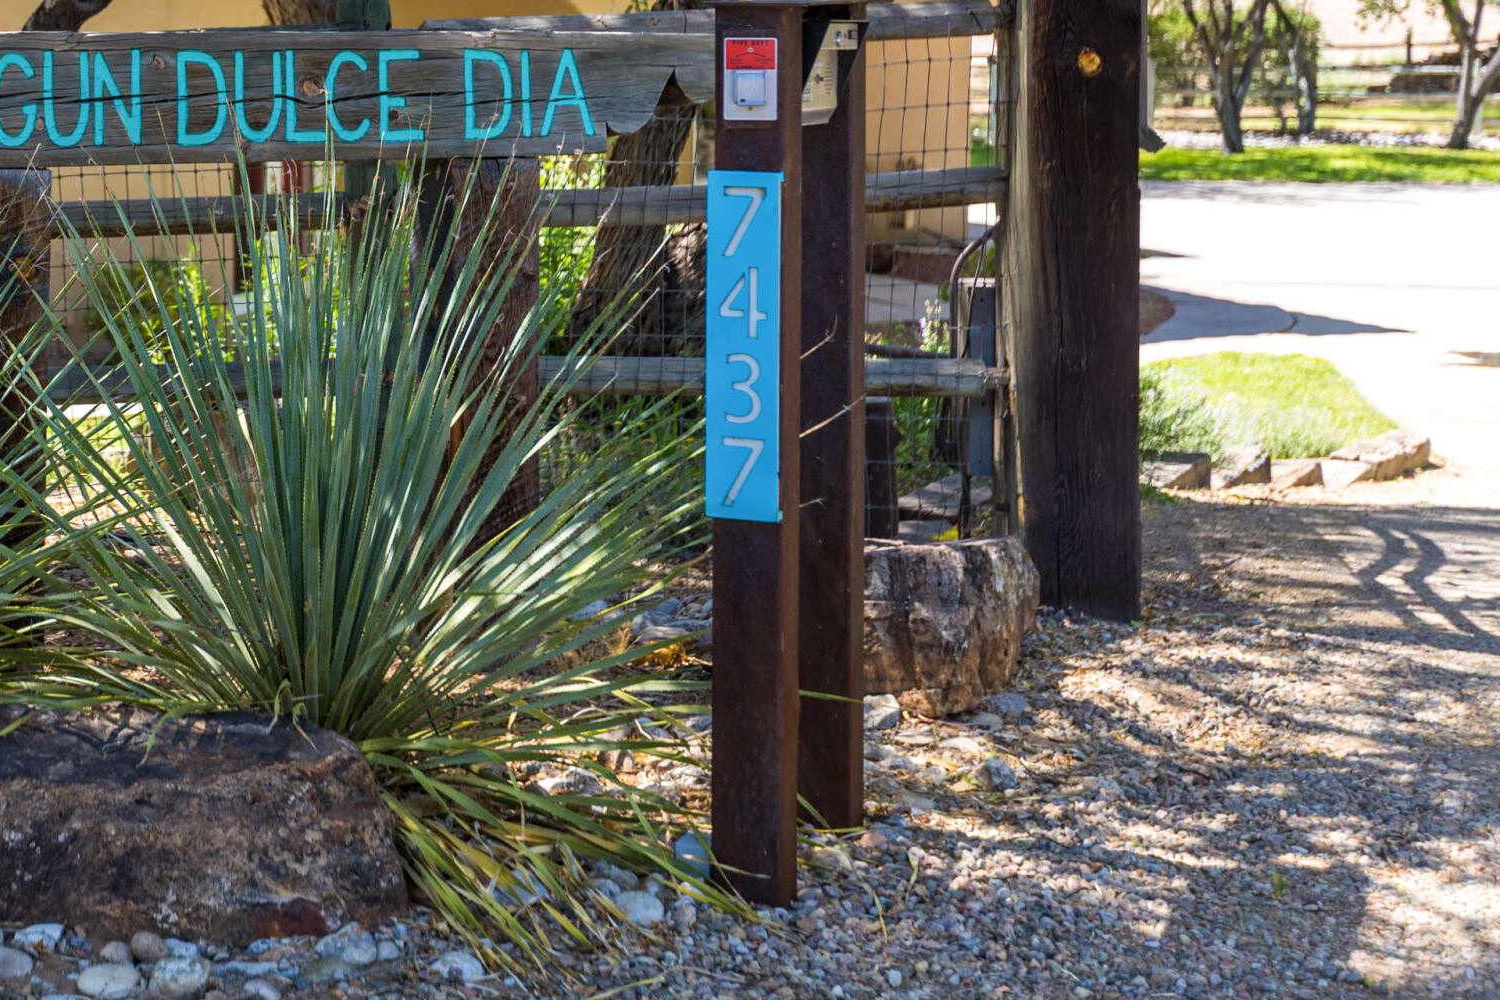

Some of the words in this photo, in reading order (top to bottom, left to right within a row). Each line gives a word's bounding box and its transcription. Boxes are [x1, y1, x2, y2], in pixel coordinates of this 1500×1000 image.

[176, 48, 425, 146] DULCE
[463, 47, 595, 141] DIA
[719, 185, 767, 507] 7437
